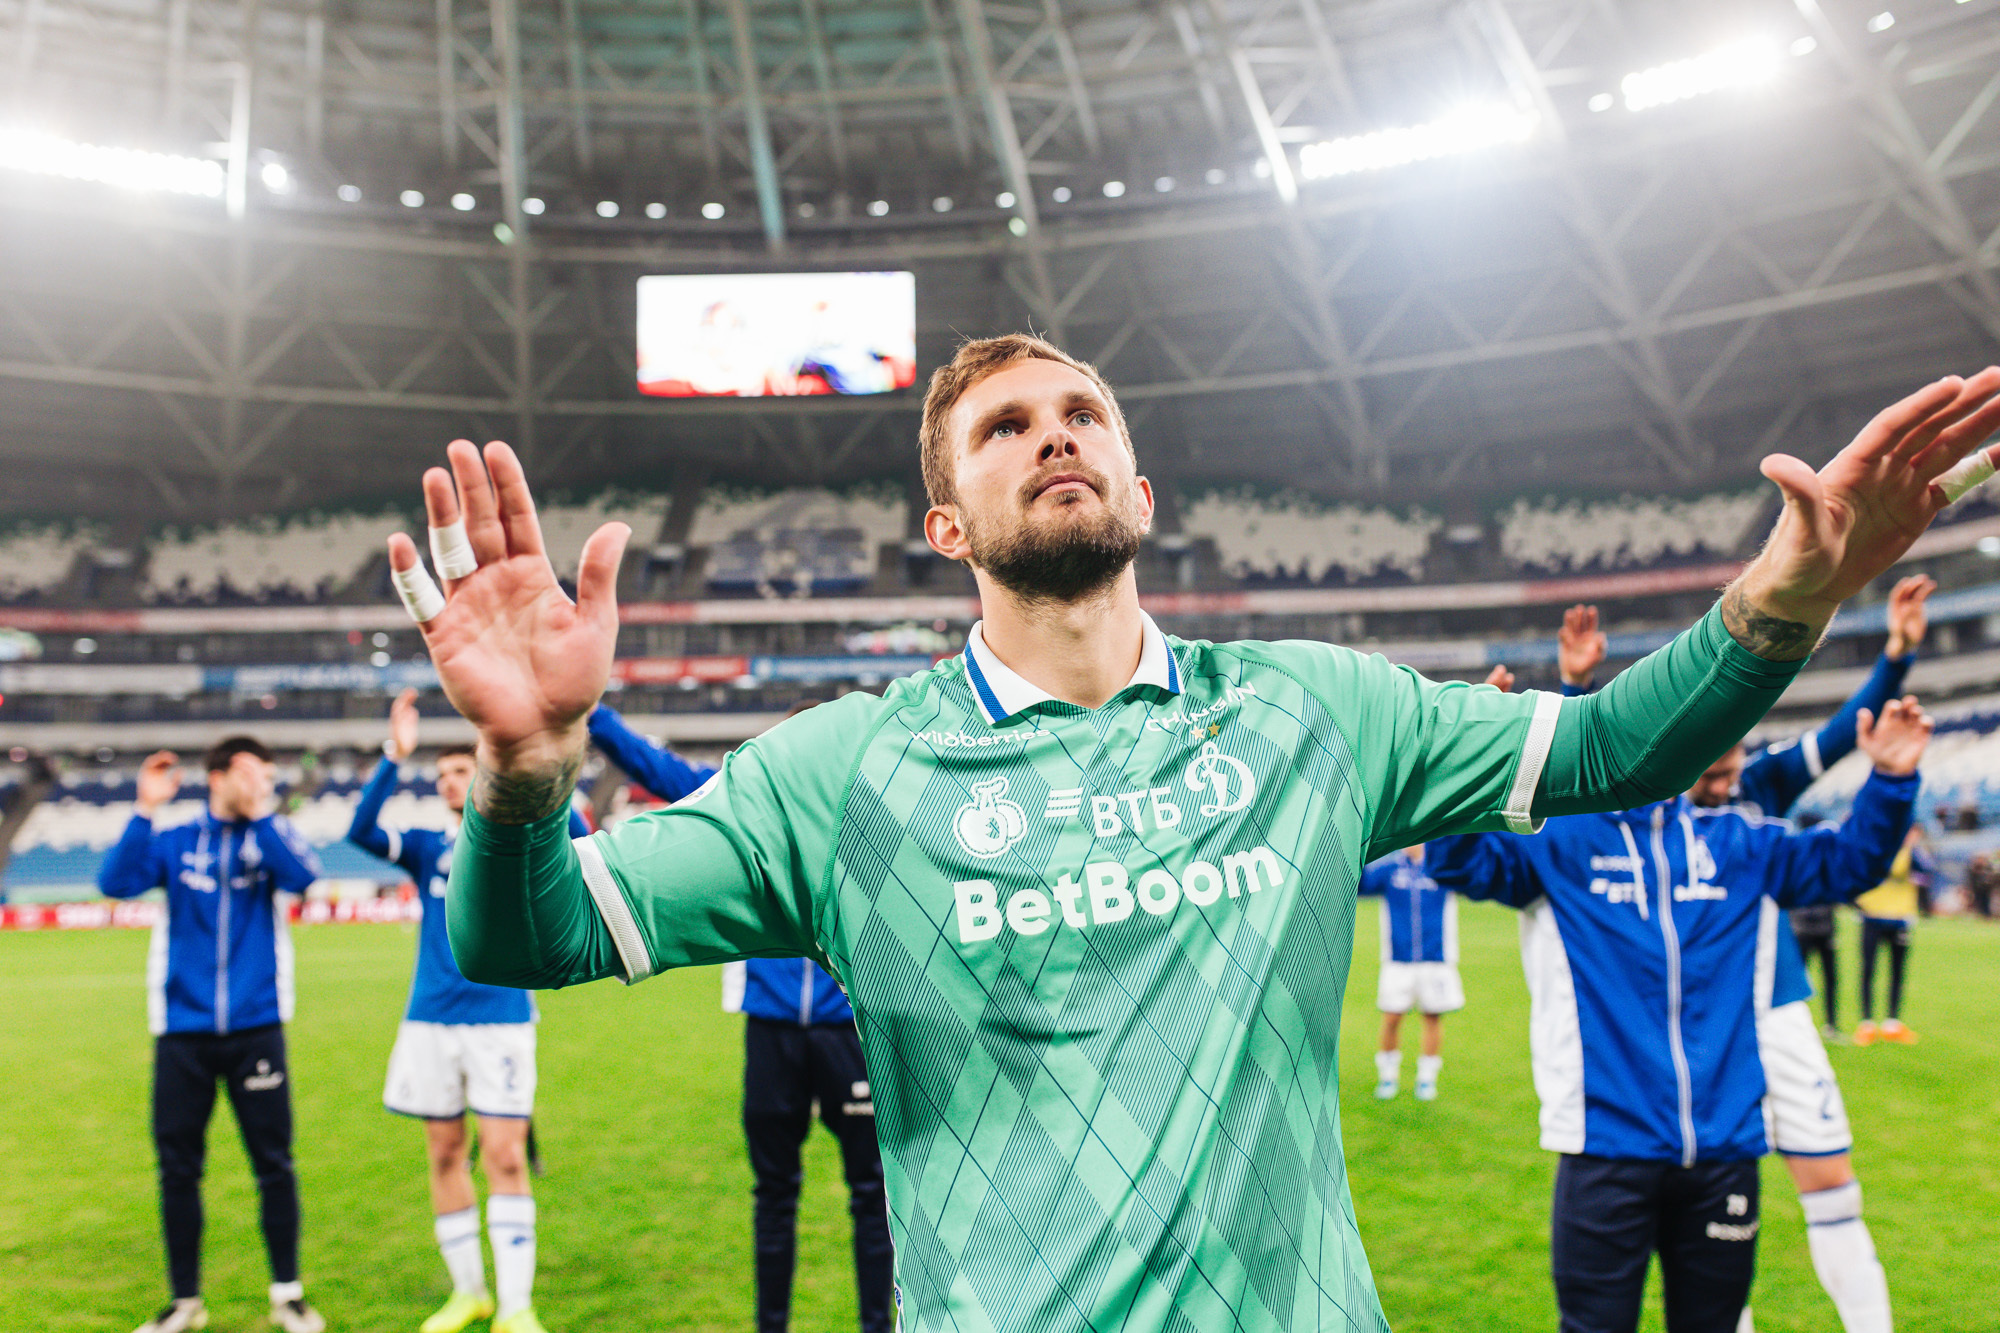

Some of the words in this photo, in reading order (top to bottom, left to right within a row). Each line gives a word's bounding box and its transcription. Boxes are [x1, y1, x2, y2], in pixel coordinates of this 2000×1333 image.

[909, 729, 1050, 747] wildberries
[1092, 786, 1182, 837] ВТБ
[953, 846, 1284, 943] BetBoom
